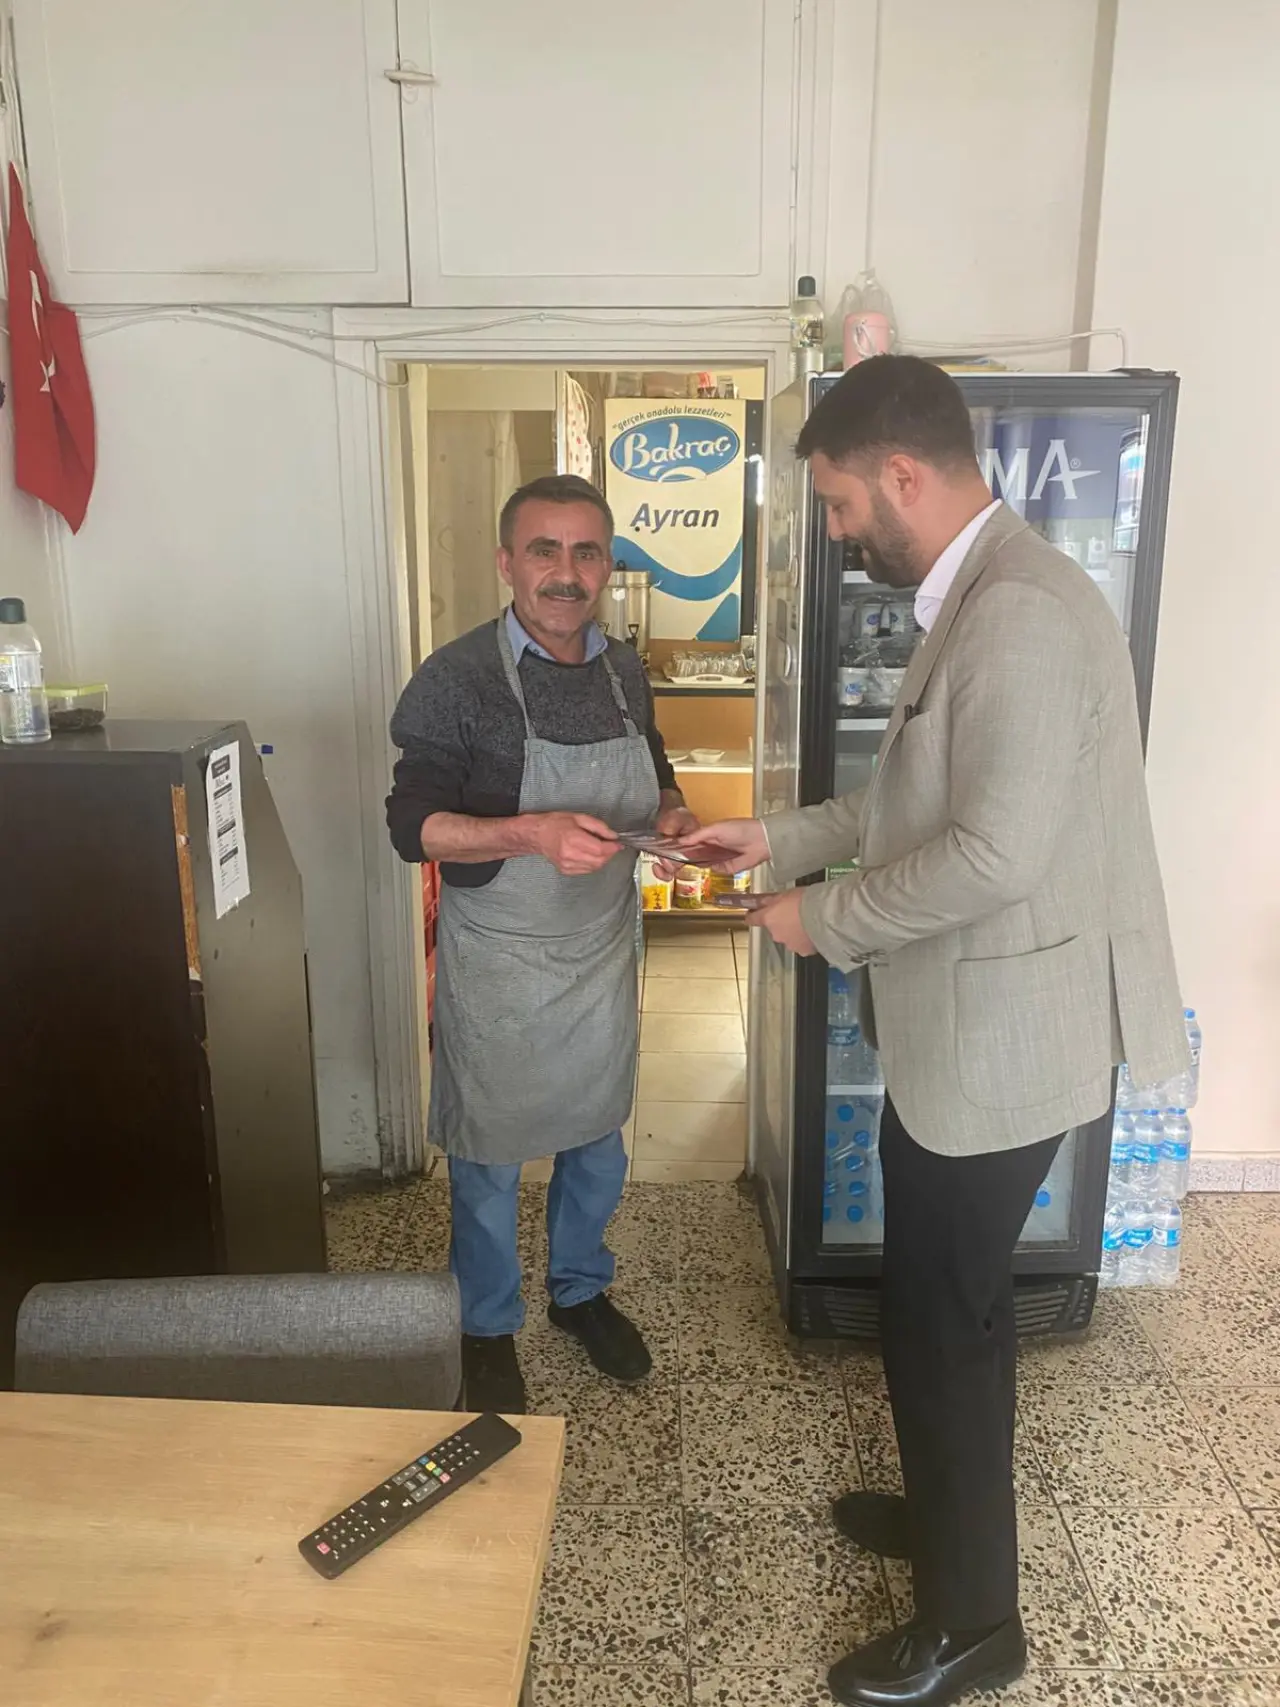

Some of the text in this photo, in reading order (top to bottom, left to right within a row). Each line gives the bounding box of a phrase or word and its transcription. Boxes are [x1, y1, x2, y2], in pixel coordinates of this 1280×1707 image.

[646, 405, 682, 418] anadolu
[622, 422, 731, 472] Bakraç
[629, 503, 720, 534] Ayran
